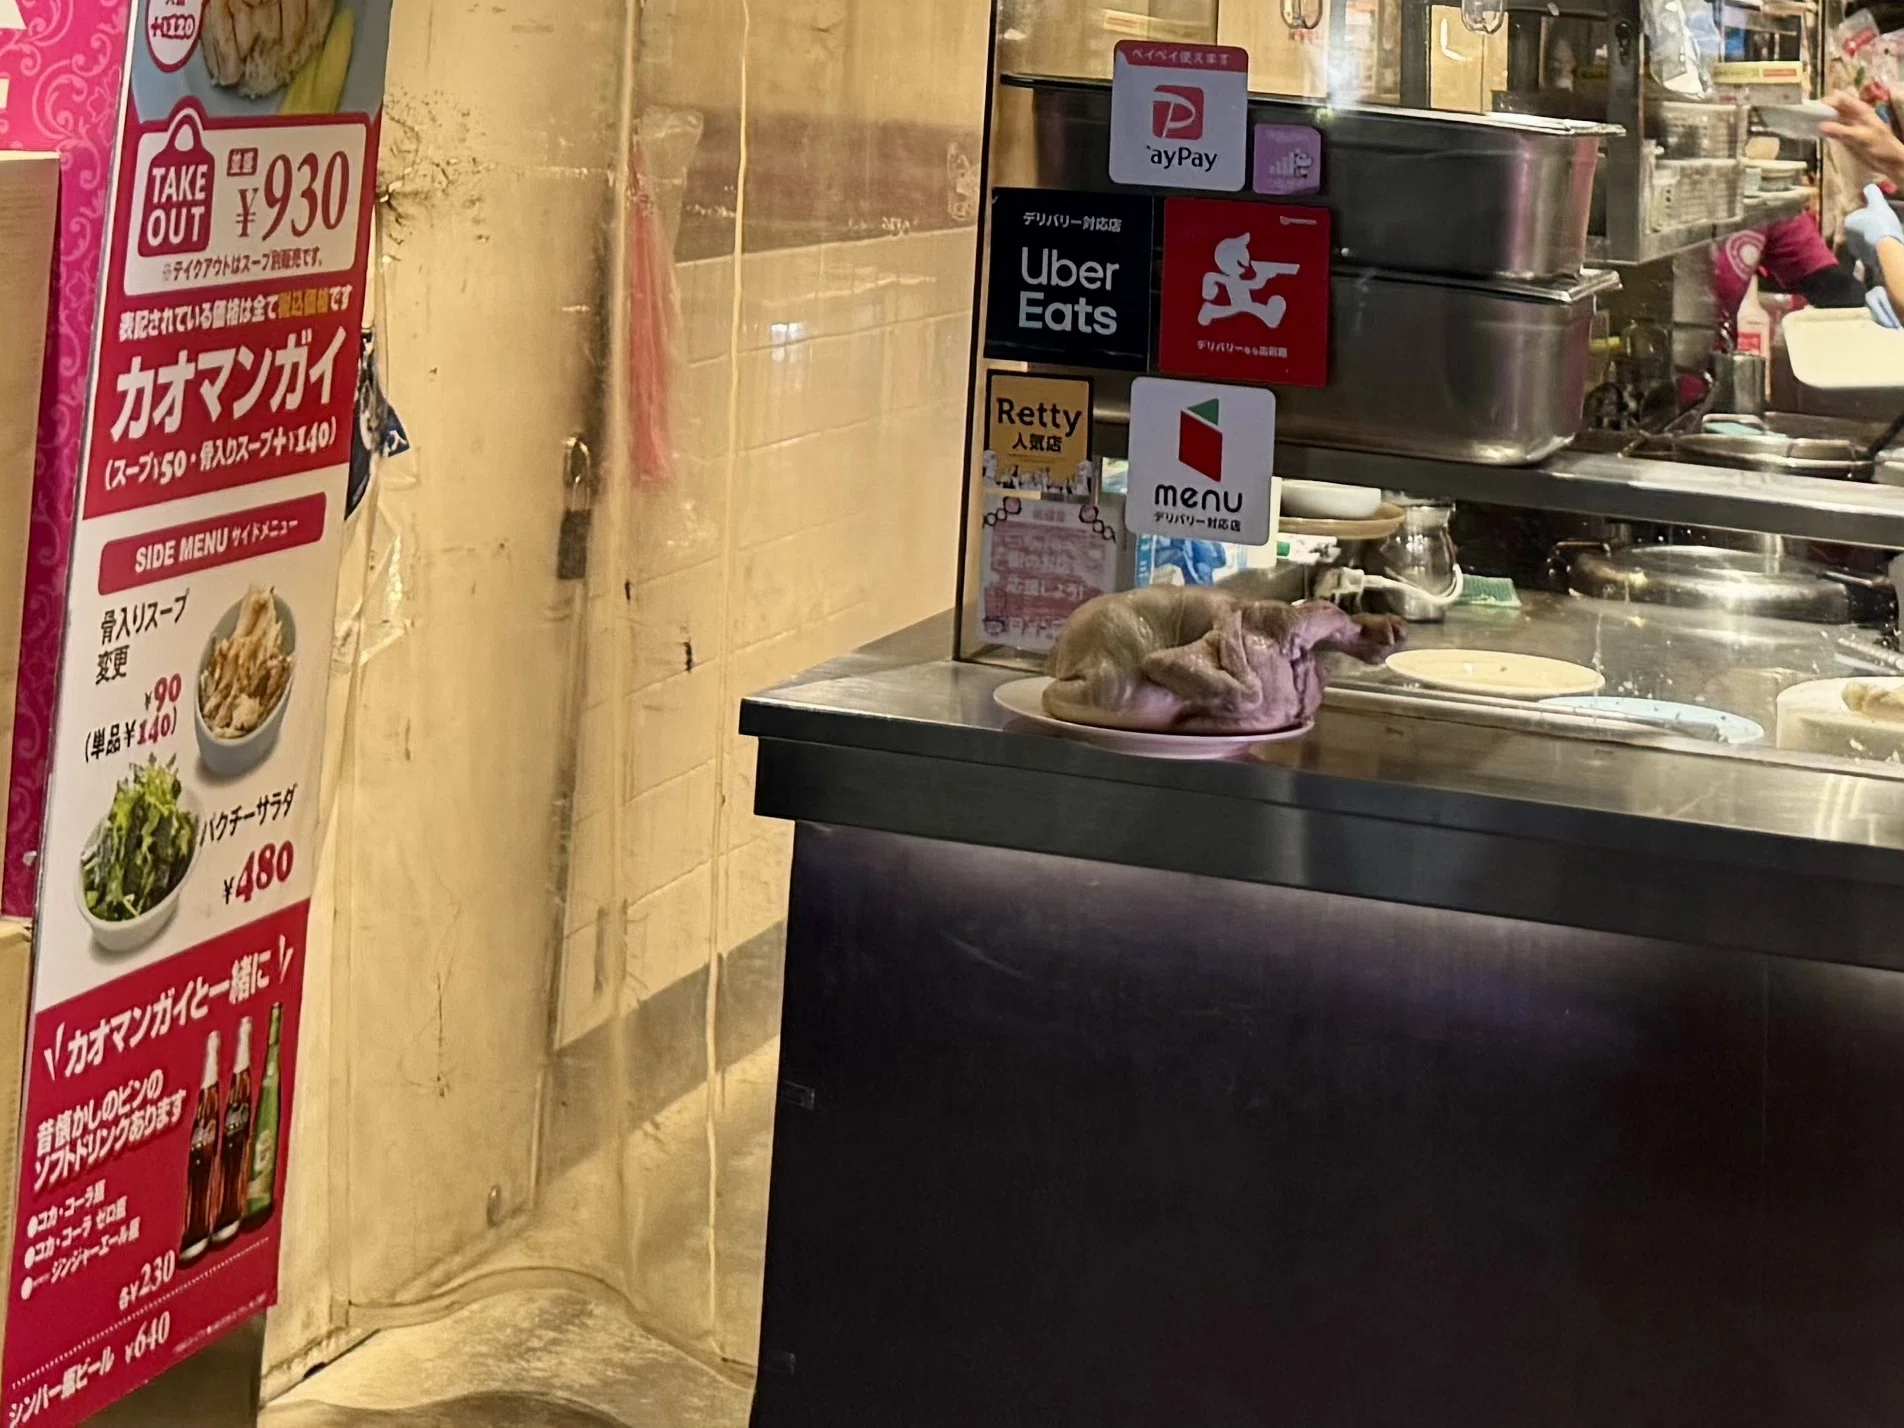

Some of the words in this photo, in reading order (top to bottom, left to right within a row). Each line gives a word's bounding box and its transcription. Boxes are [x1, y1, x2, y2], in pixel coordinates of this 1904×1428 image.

[1146, 144, 1218, 173] ayPay
[151, 163, 208, 204] TAKE
[235, 150, 351, 243] ¥930
[146, 205, 205, 247] OUT
[1020, 246, 1120, 291] Uber
[1018, 291, 1119, 336] Eats
[110, 325, 347, 443] カオマンガイ
[995, 396, 1083, 437] Retty
[1011, 431, 1063, 453] 人気店
[1154, 483, 1244, 514] menu
[1153, 512, 1242, 533] デリバリー対応店
[134, 540, 175, 574] SIDE
[179, 526, 229, 564] MENU
[100, 587, 191, 646] 骨入りスープ
[144, 673, 182, 711] ¥90
[223, 840, 295, 905] ¥480
